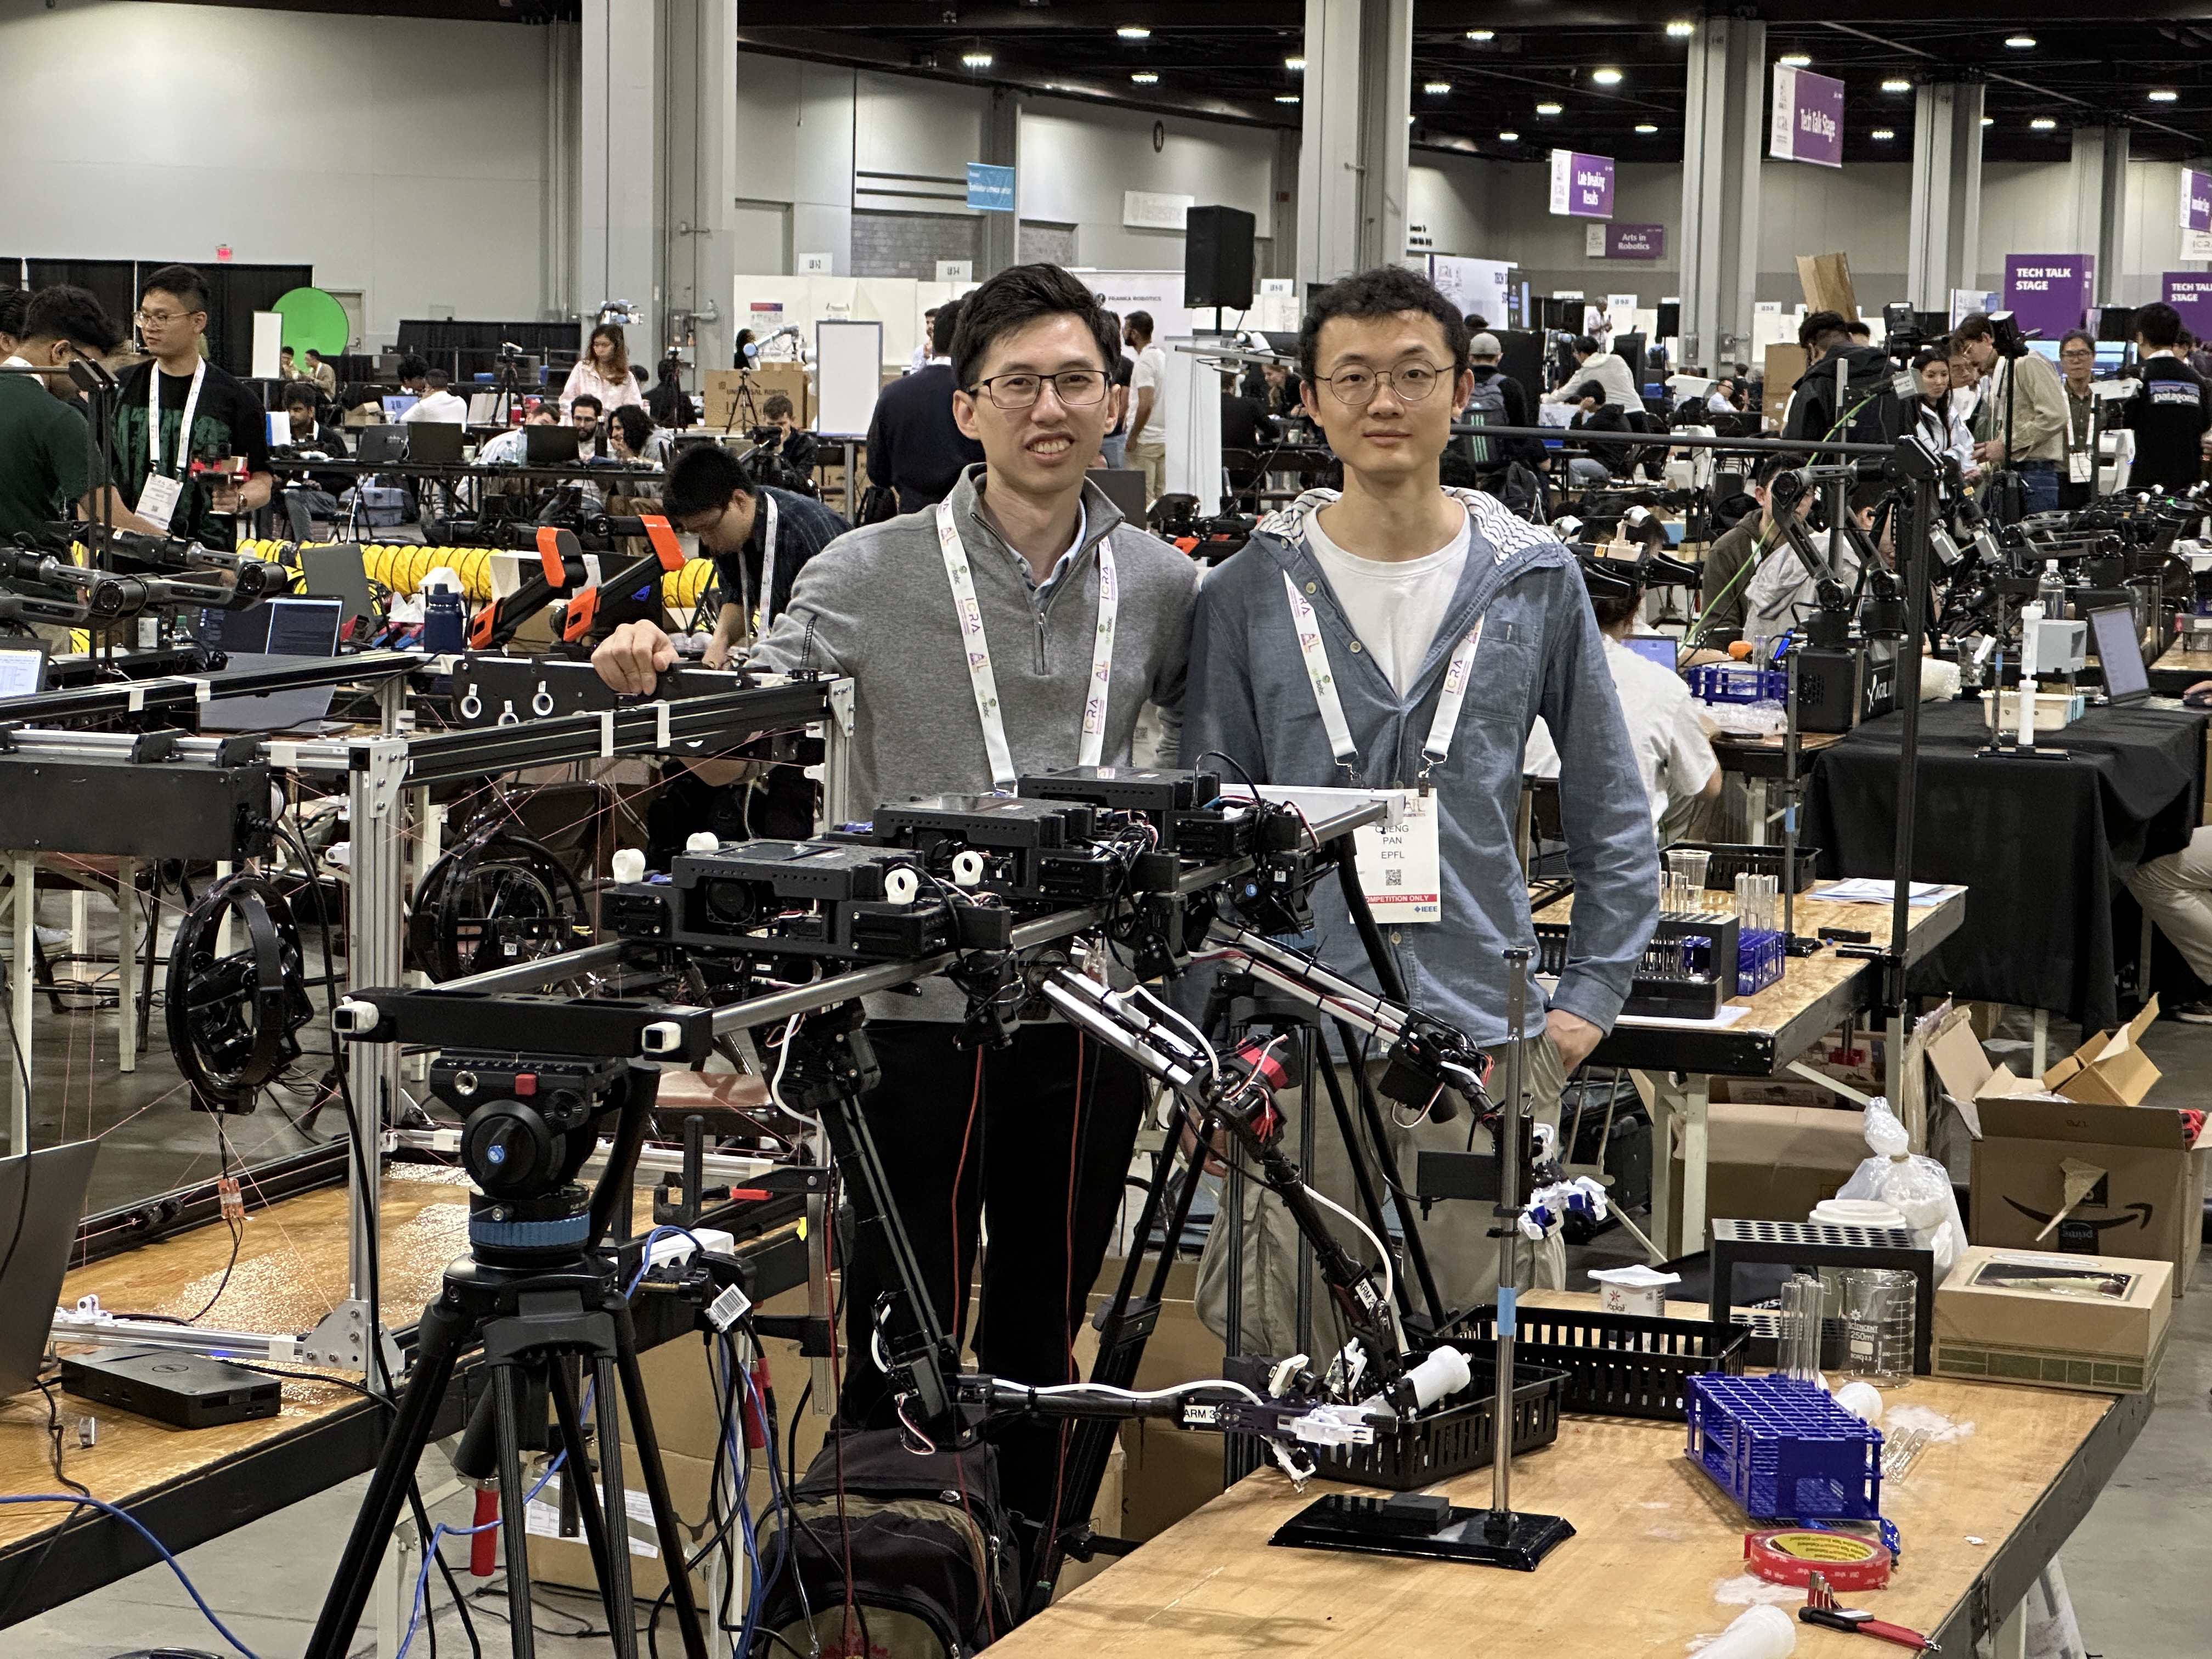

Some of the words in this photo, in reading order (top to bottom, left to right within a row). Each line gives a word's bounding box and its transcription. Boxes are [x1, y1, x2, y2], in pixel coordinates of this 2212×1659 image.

[1622, 233, 1637, 241] Arts
[1639, 233, 1646, 241] in
[2016, 268, 2044, 278] TECH
[2045, 268, 2072, 278] TALK
[2016, 280, 2049, 290] STAGE
[2171, 294, 2198, 302] STAGE
[1101, 564, 1109, 600] ICRA
[966, 597, 980, 636] ICRA
[1444, 658, 1463, 694] ICRA
[1084, 696, 1098, 734] ICRA
[1375, 825, 1409, 833] CHENG
[1383, 837, 1402, 845] PAN
[1357, 1282, 1372, 1300] ARM
[1850, 1331, 1875, 1342] 250ml
[1185, 1409, 1206, 1419] ARM
[1210, 1409, 1215, 1419] 3
